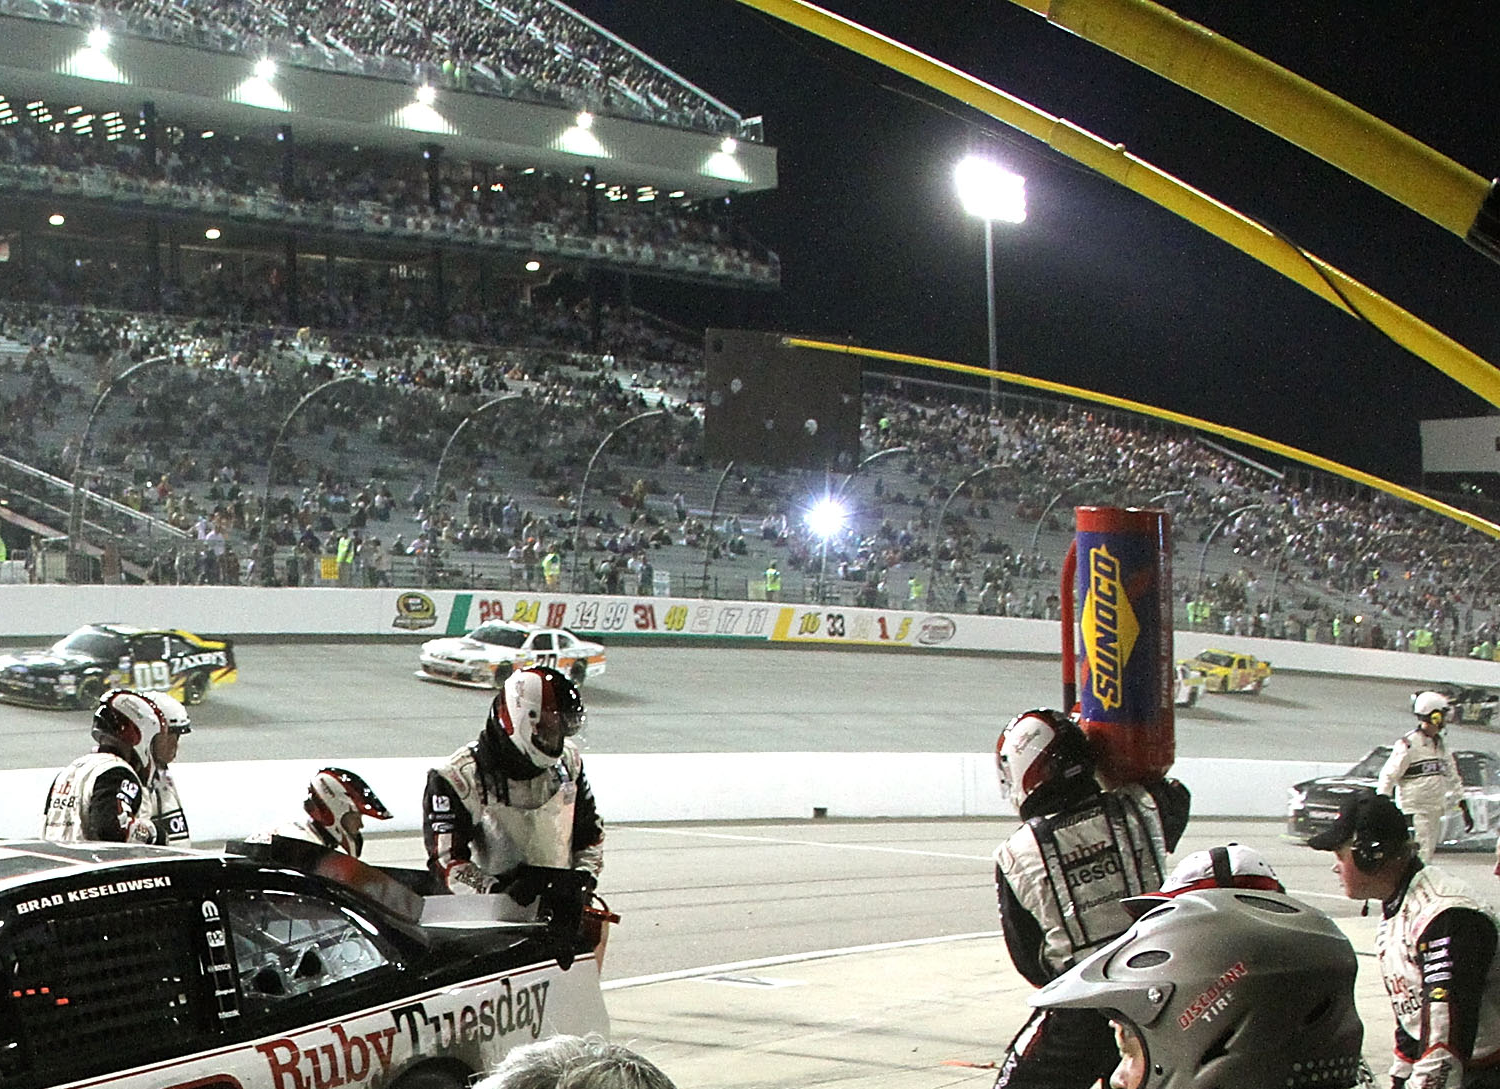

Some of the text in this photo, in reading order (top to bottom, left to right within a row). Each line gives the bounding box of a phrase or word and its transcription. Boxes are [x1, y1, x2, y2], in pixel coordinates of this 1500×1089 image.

[513, 600, 541, 623] 24
[547, 603, 566, 628] 18
[571, 602, 599, 629] 14
[602, 604, 628, 630] 99
[633, 605, 657, 630] 31
[664, 605, 688, 631] 48
[716, 608, 743, 633] 17
[745, 608, 768, 634] 11
[826, 614, 846, 637] 33
[877, 617, 888, 640] 1
[895, 618, 912, 641] 5
[1094, 555, 1118, 702] SUNOCO
[133, 661, 170, 691] 09
[16, 876, 171, 914] BRAD KESELOWSKI
[1178, 961, 1249, 1030] DISCOUNT
[390, 976, 550, 1058] Tuesday
